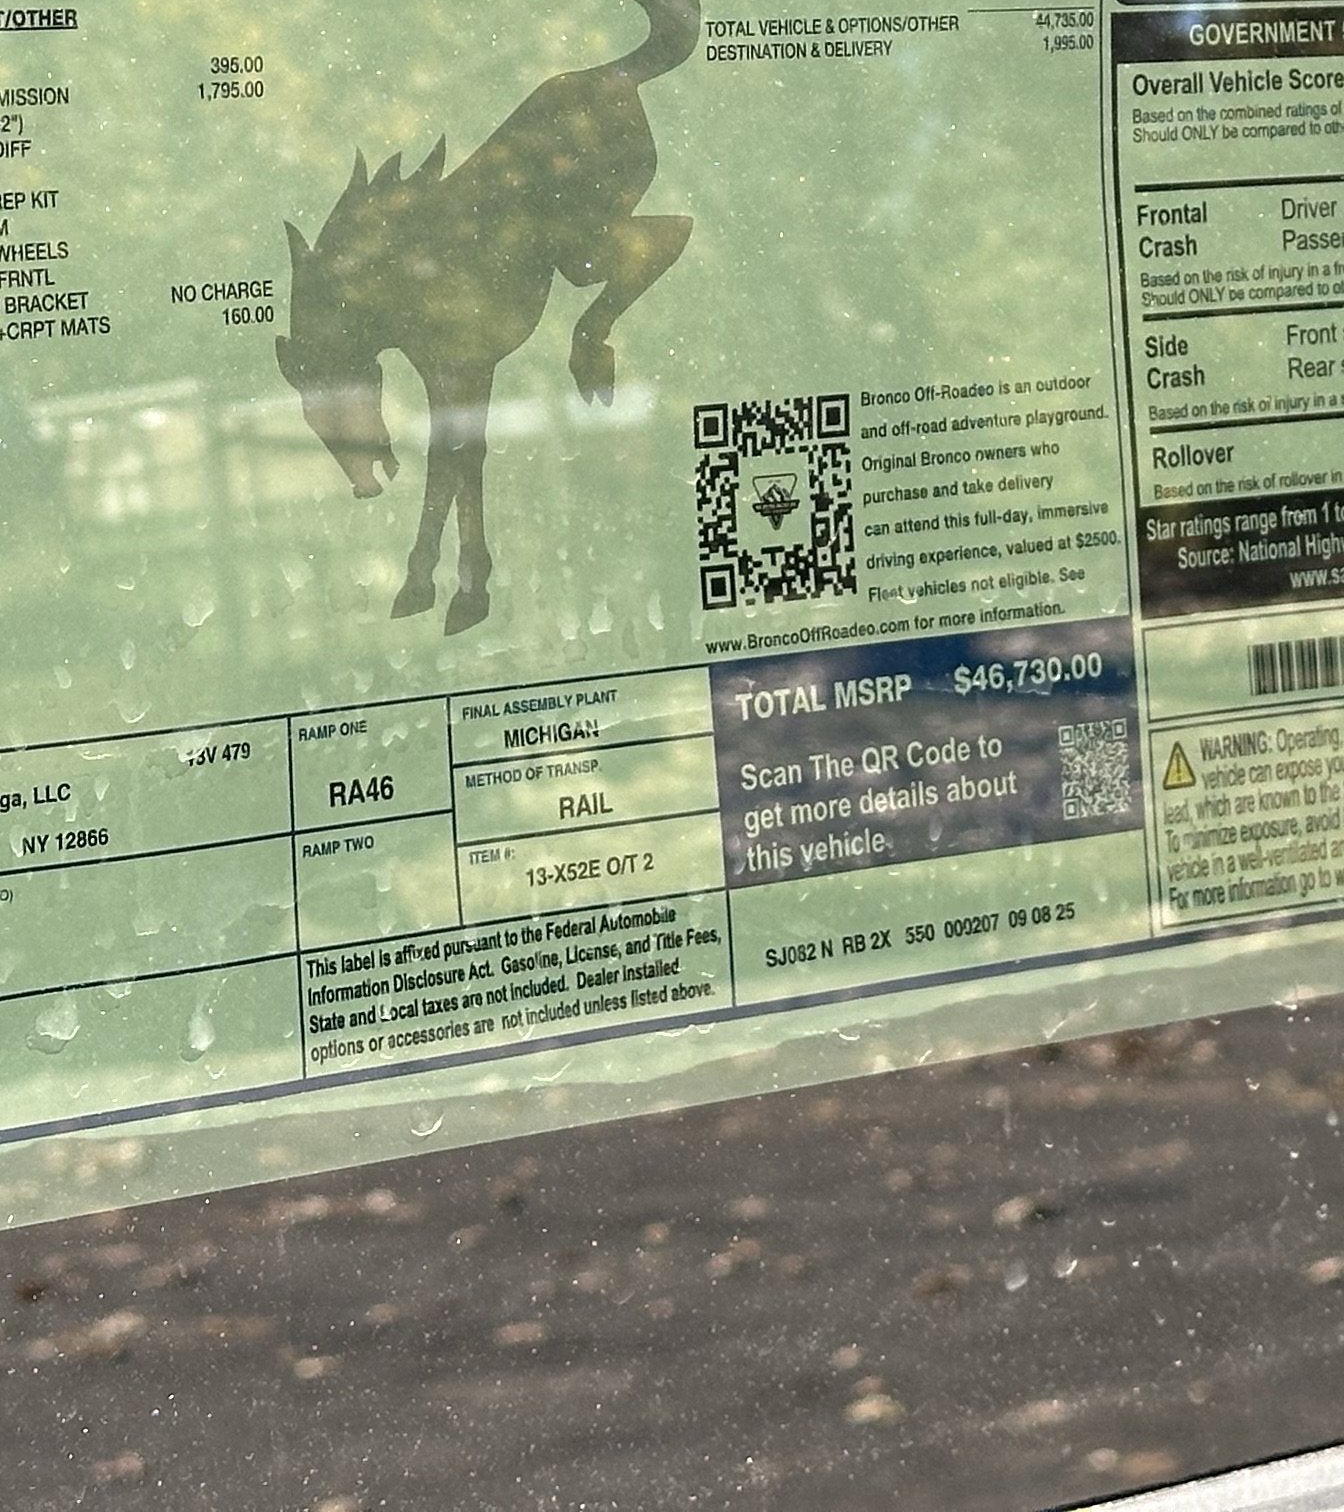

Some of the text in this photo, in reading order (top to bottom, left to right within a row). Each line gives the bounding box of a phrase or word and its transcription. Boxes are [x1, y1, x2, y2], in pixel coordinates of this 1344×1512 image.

[1186, 20, 1335, 45] GOVERNMENT
[198, 81, 264, 101] 1,795.00
[1131, 68, 1344, 96] Overall Vehicle Score
[1137, 201, 1208, 227] Frontal
[1281, 197, 1337, 220] Driver
[1139, 235, 1197, 258] Crash
[860, 375, 1091, 407] Bronco Off-Roadeo is an outdoor
[1153, 443, 1234, 469] Rollover
[735, 651, 1102, 721] TOTAL MSRP $46,730.00
[504, 720, 599, 749] MICHIGAN
[741, 736, 1003, 790] Scan The QR Code to
[32, 785, 71, 808] LLC
[329, 775, 394, 808] RA46
[559, 793, 613, 819] RAIL
[21, 834, 49, 856] NY
[54, 827, 109, 852] 12866
[526, 860, 601, 887] 13-X52E
[644, 853, 654, 871] 2
